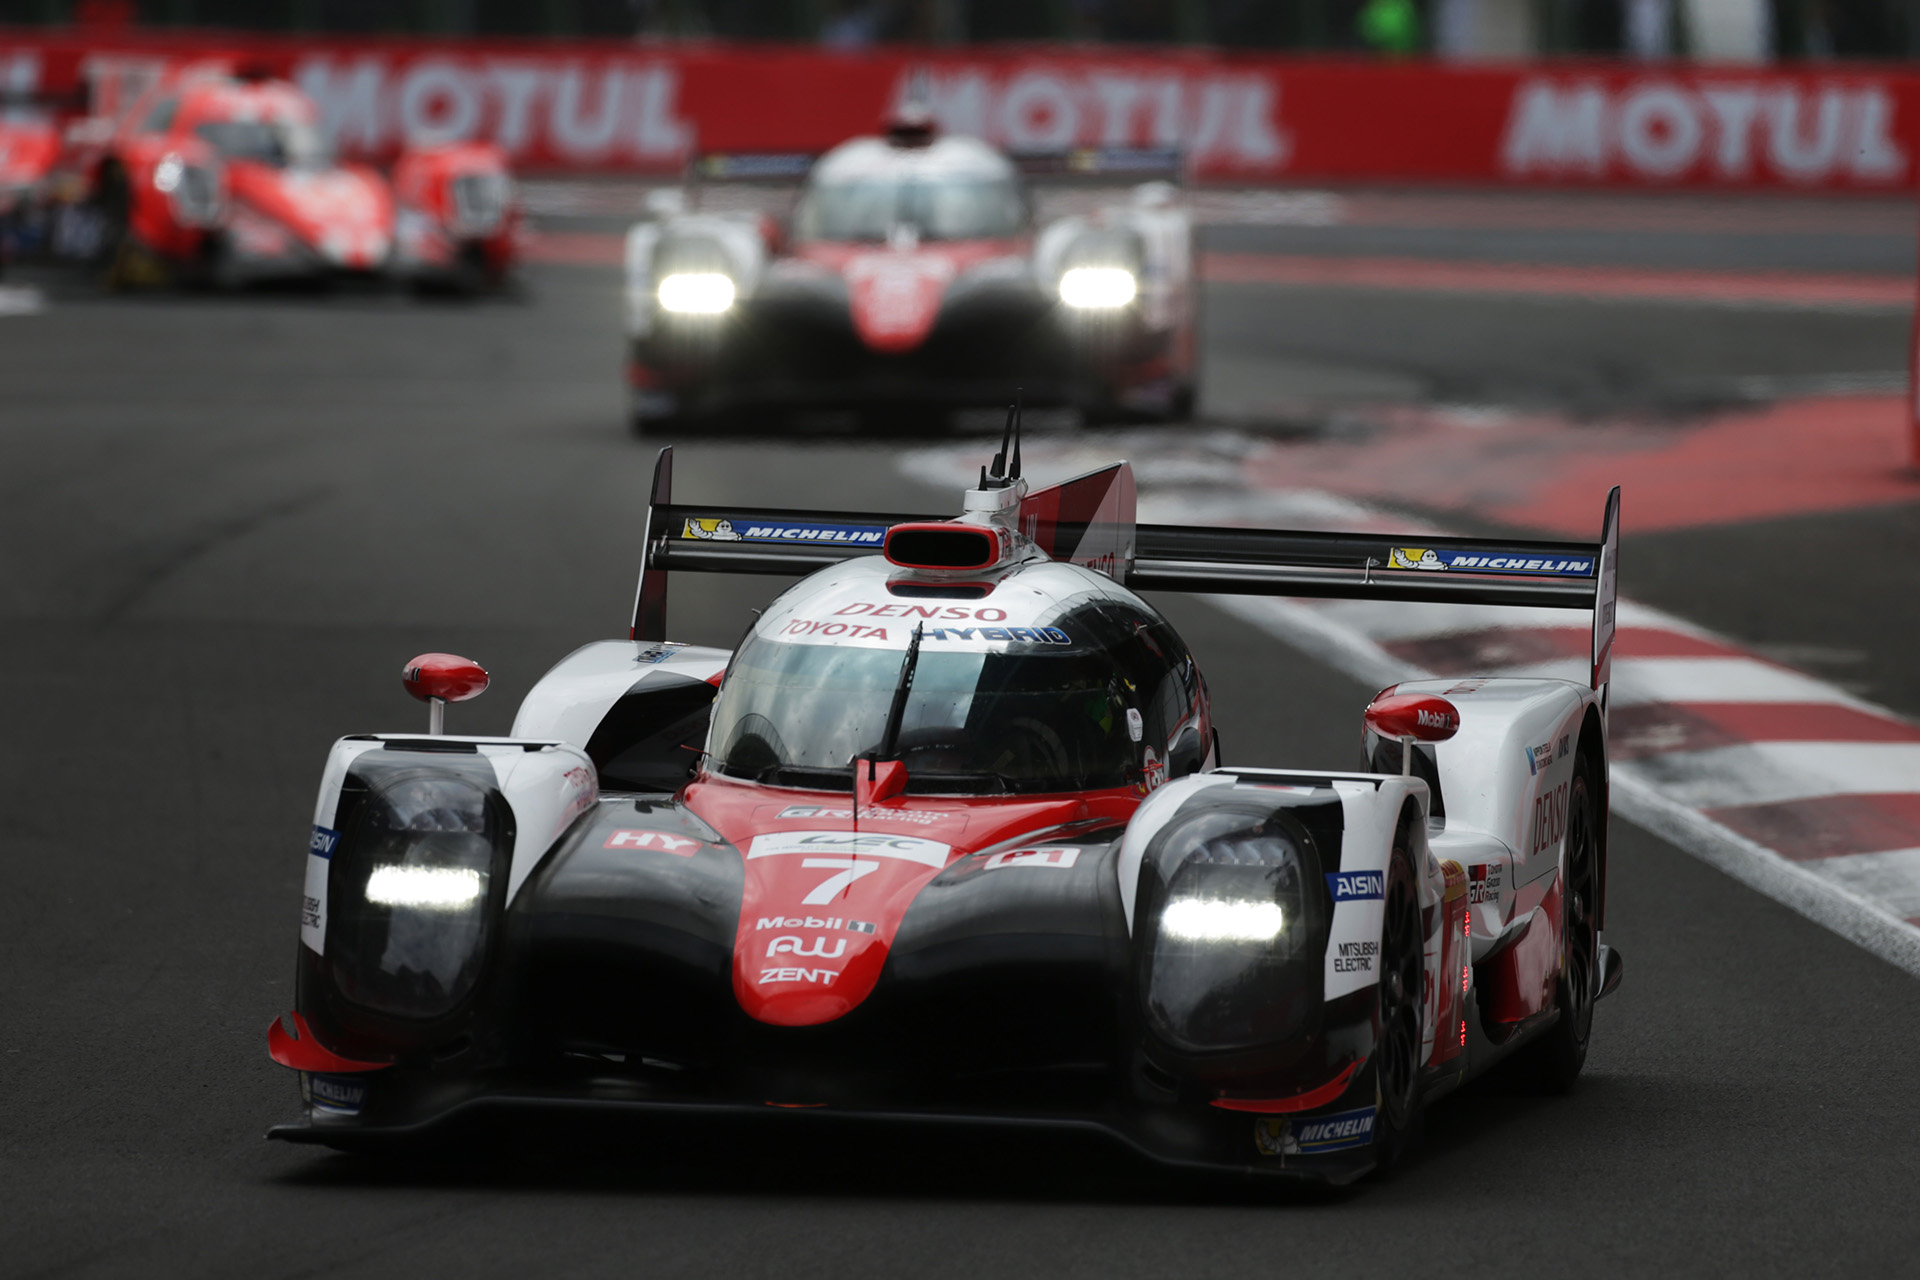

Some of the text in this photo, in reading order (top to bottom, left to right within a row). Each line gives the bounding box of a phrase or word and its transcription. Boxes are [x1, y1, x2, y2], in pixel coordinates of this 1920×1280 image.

[296, 57, 693, 156] MOTUL
[890, 68, 1288, 163] MOTUL
[1505, 83, 1902, 176] MOTUL
[745, 527, 883, 542] MICHELIN
[1451, 556, 1590, 572] MICHELIN
[832, 602, 1008, 622] DENSO
[780, 619, 1072, 645] TOYOTA HYBRID
[1417, 709, 1444, 729] Mobil
[777, 806, 853, 819] GR
[1533, 781, 1568, 857] DENSO
[610, 831, 697, 850] HY
[798, 835, 925, 850] WEC
[1000, 850, 1064, 864] P1
[801, 858, 880, 905] 7
[1336, 876, 1382, 896] AISIN
[756, 916, 843, 930] Mobil
[766, 935, 847, 958] AW
[1338, 941, 1379, 957] MITSUBISH
[1334, 957, 1372, 972] ELECTRIC
[758, 967, 840, 985] ZENT
[1300, 1116, 1374, 1141] MICHELIN
